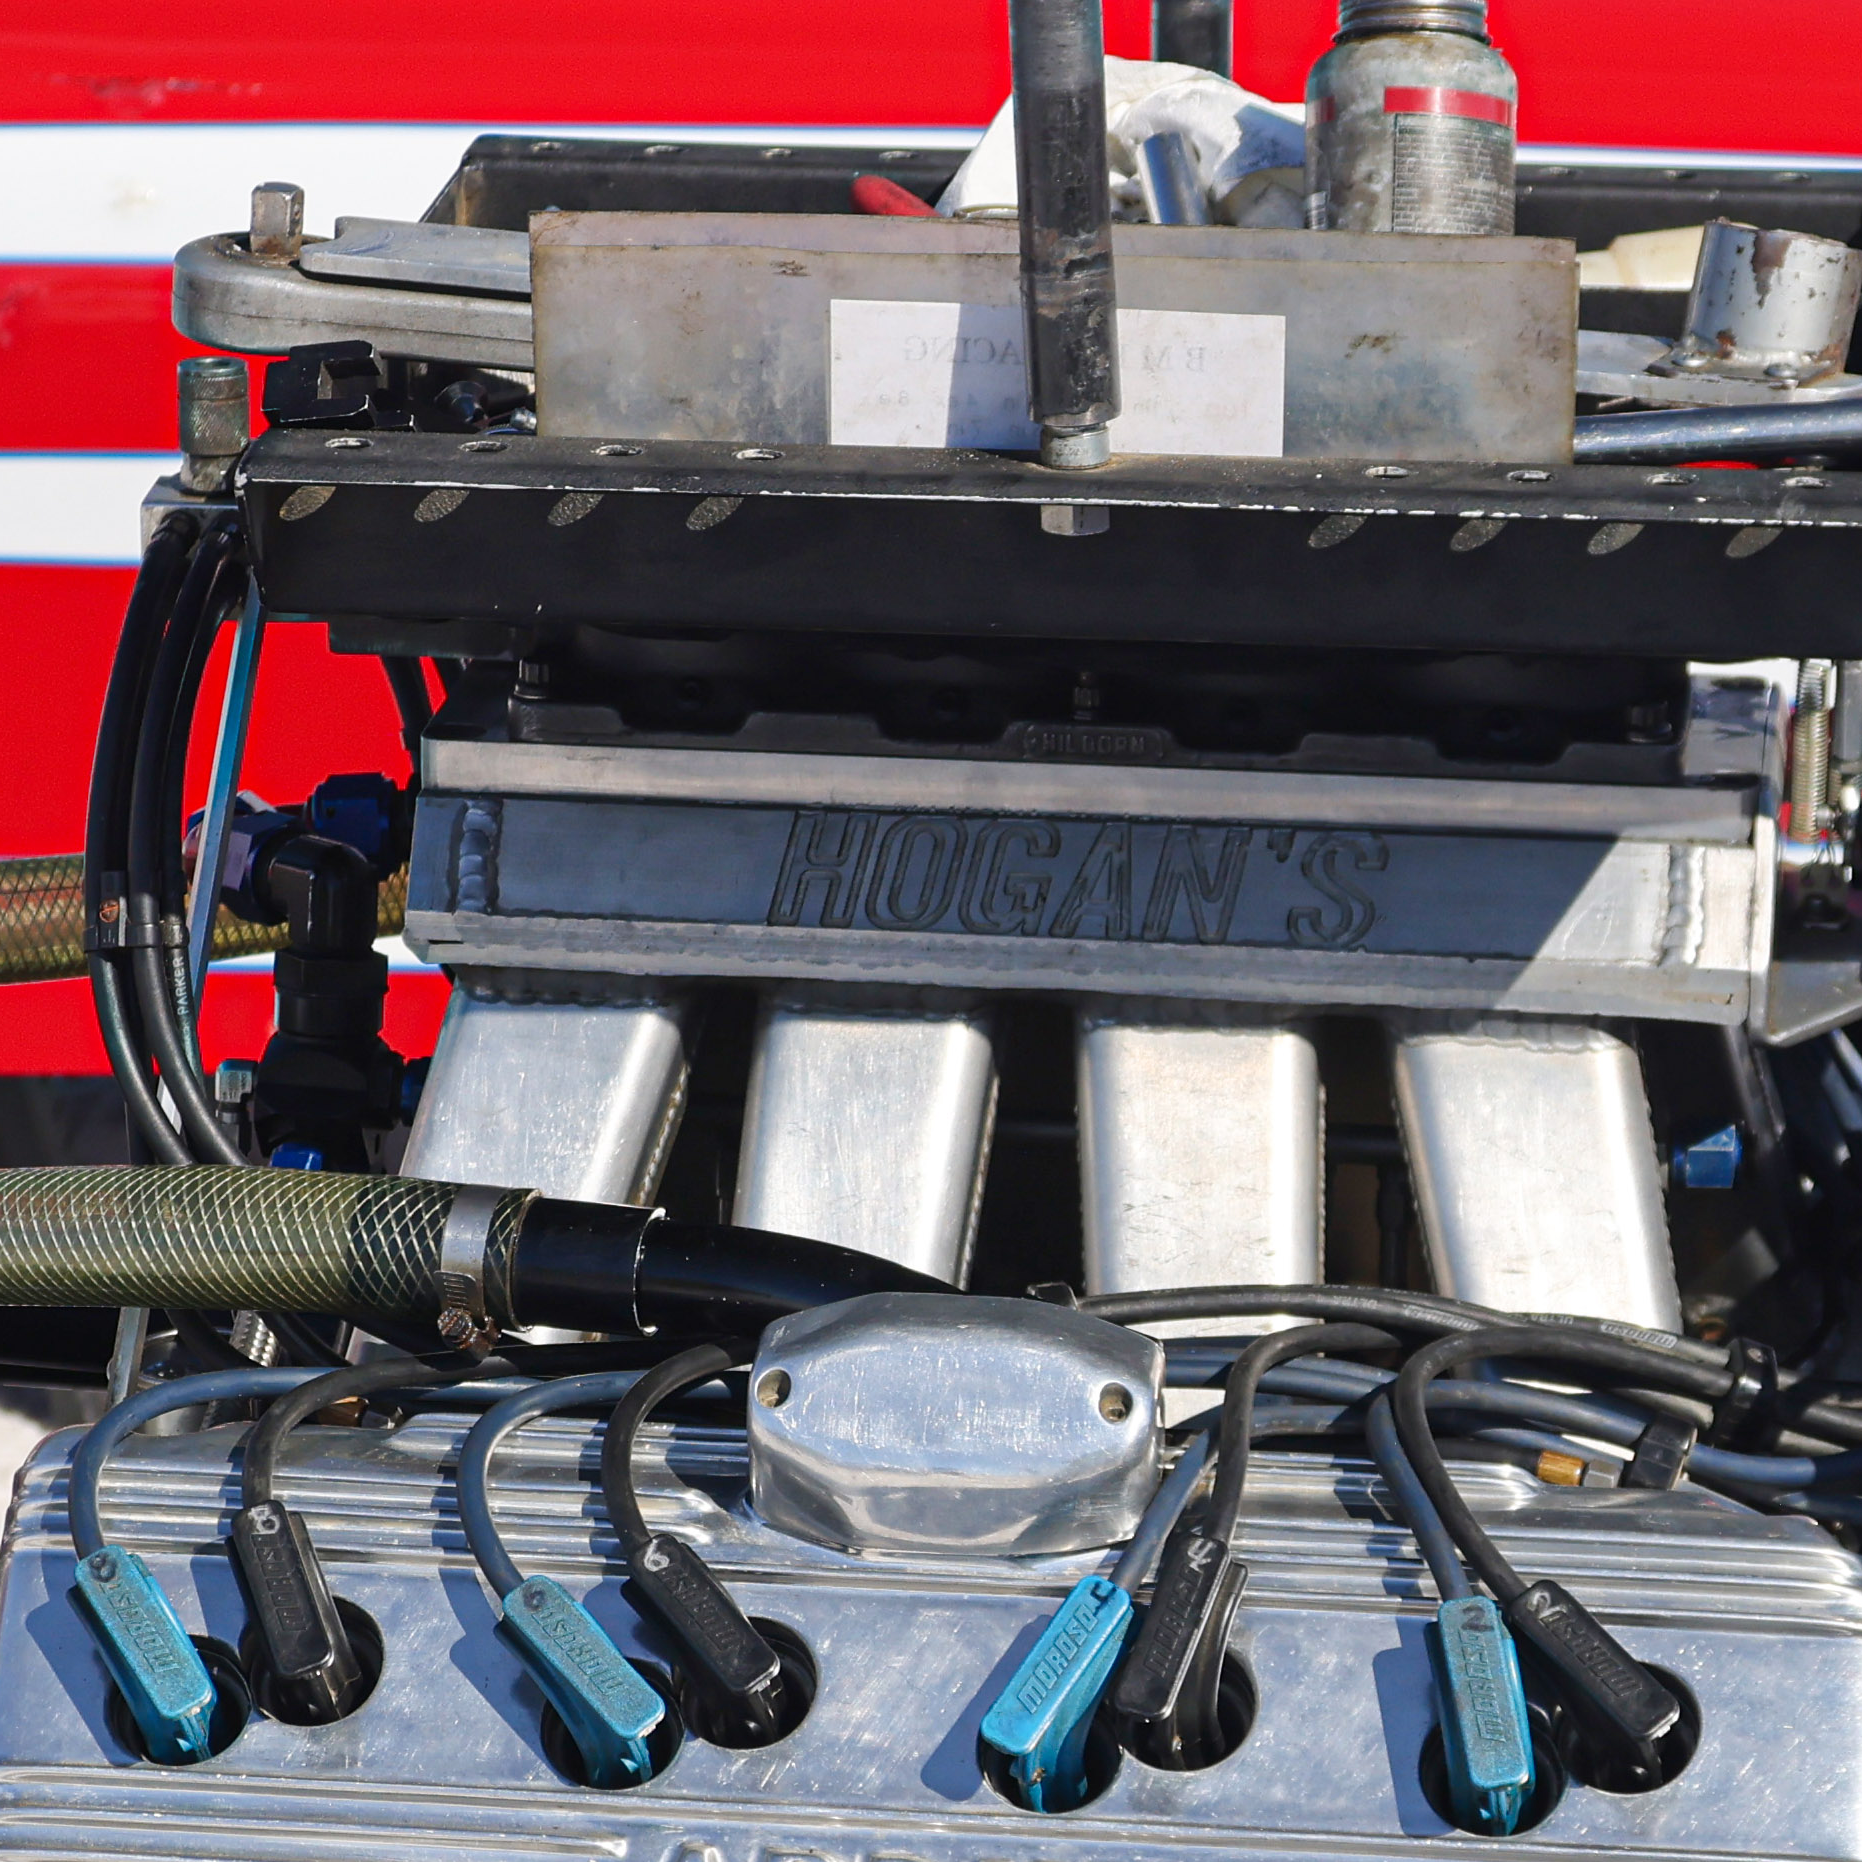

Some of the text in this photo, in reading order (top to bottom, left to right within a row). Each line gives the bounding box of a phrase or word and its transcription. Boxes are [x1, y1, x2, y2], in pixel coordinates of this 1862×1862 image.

[766, 809, 1389, 949] HOGAN'S
[644, 1539, 670, 1572] 6
[1016, 1603, 1100, 1715] MOROSO
